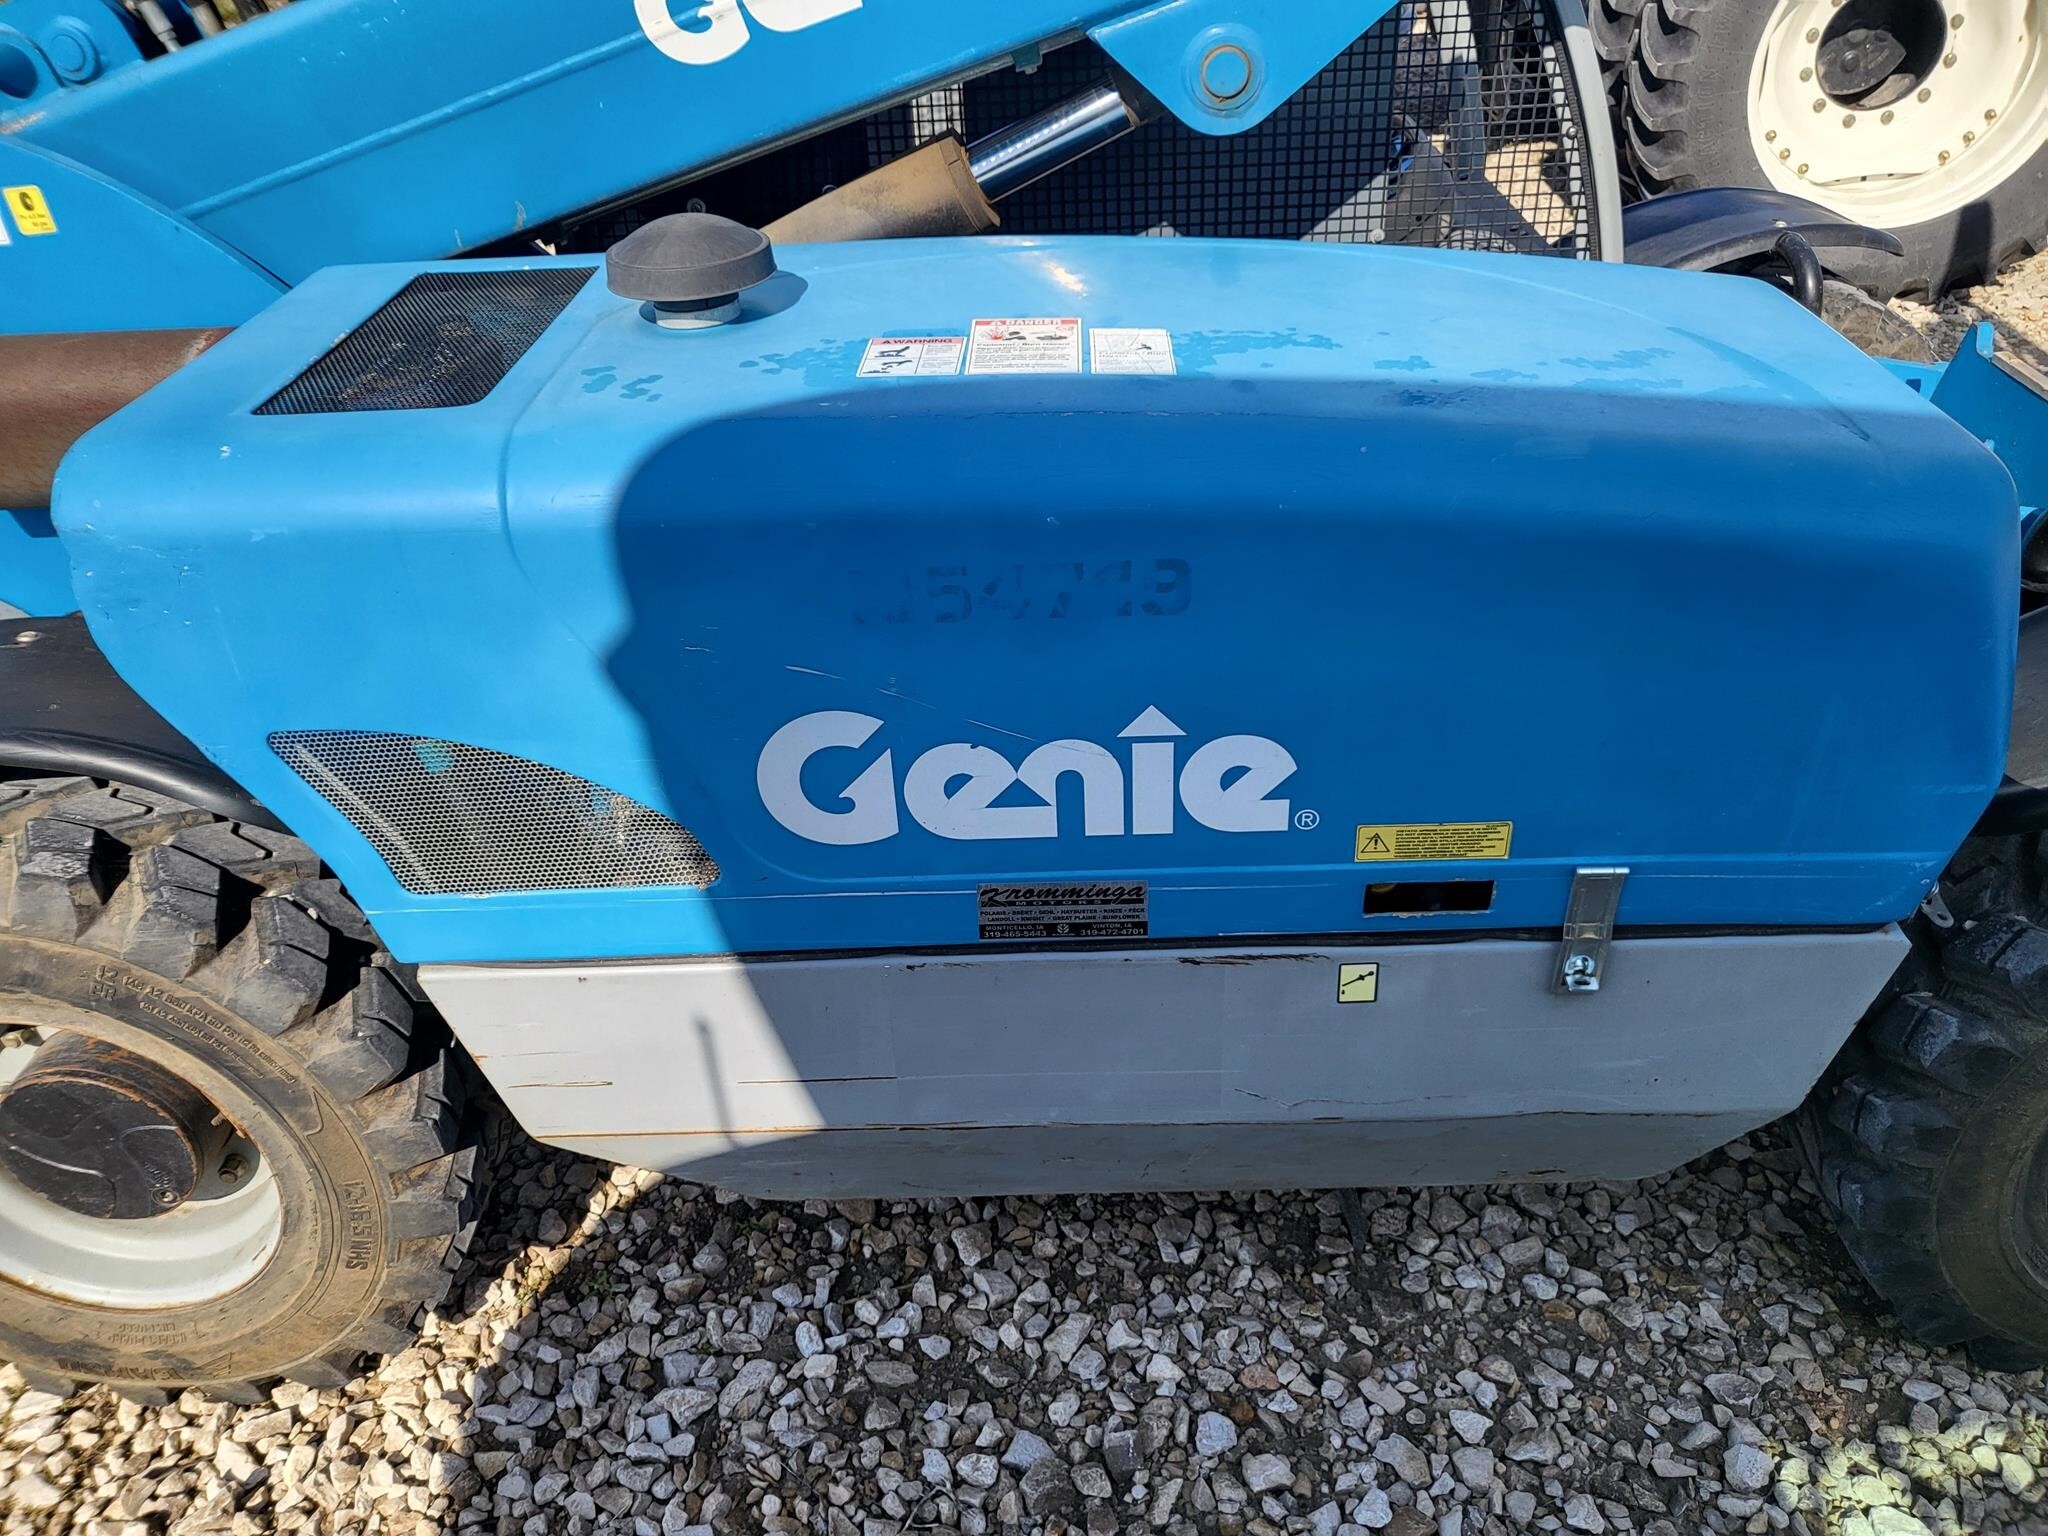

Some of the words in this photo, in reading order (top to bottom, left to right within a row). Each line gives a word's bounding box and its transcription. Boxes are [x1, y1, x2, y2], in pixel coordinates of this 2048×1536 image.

[757, 704, 1298, 845] Genie
[984, 930, 1047, 938] 319-465-5443
[1080, 928, 1144, 936] 319-472-4701
[345, 1239, 371, 1270] NHS
